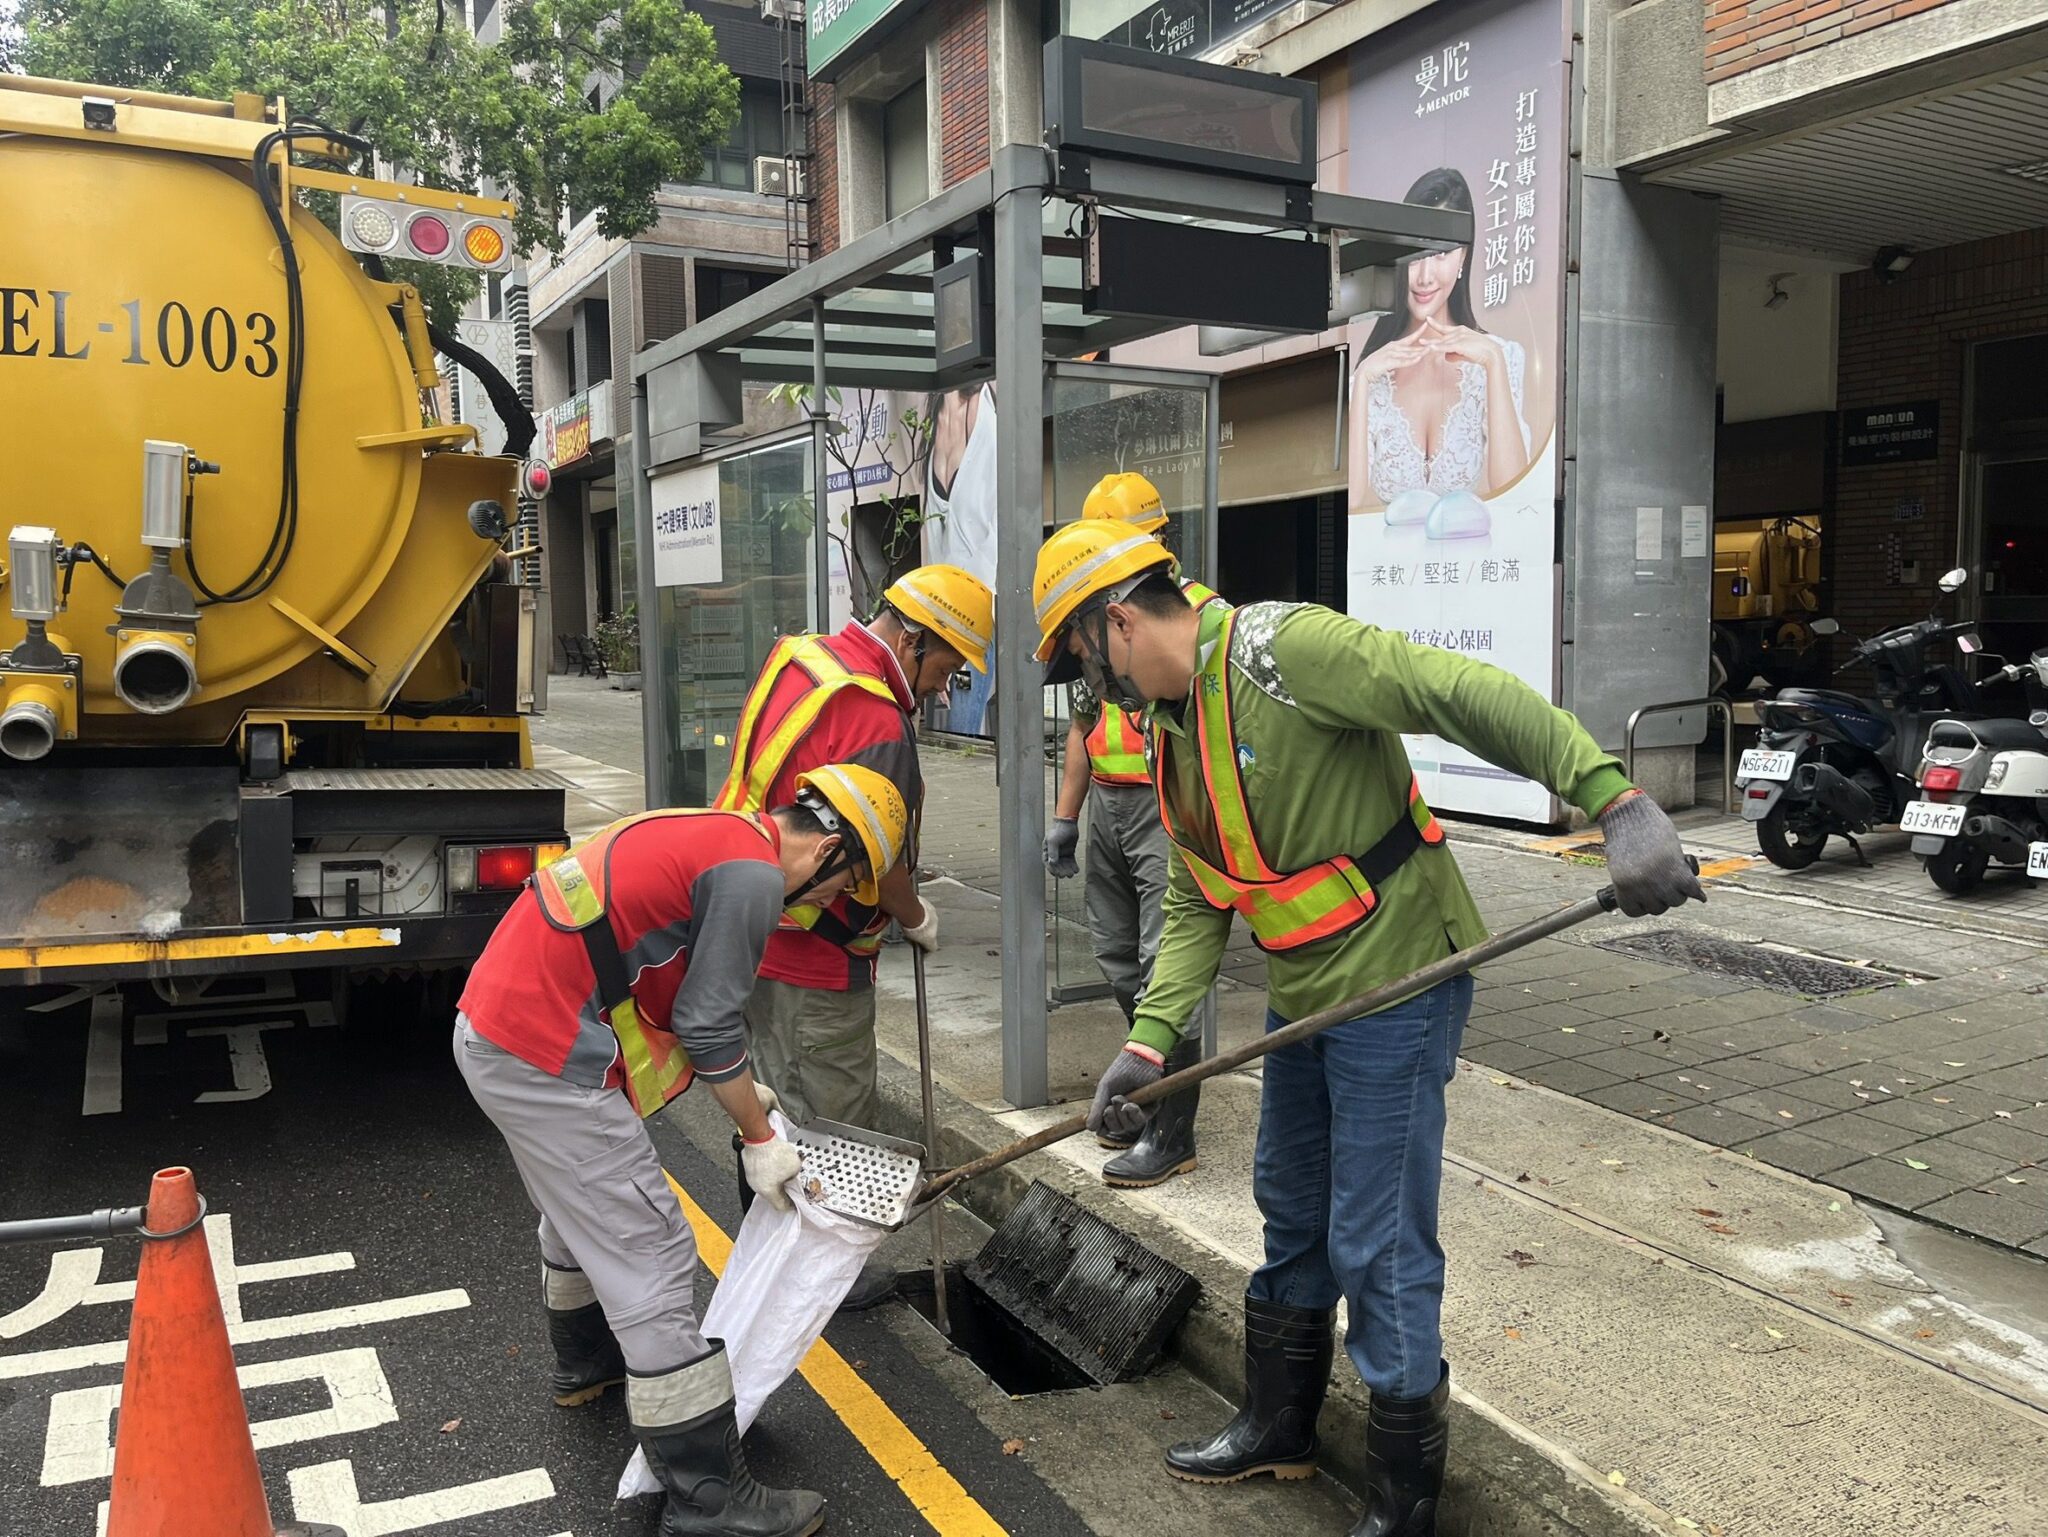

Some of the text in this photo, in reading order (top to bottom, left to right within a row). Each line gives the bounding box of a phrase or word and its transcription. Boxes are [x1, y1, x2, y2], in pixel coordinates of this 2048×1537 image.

[1414, 41, 1471, 98] 曼陀
[1513, 88, 1539, 287] 打造專屬你的
[1484, 158, 1509, 309] 女王波動
[826, 402, 888, 453] 王波動
[1166, 458, 1190, 474] Lady
[2030, 851, 2048, 869] EN
